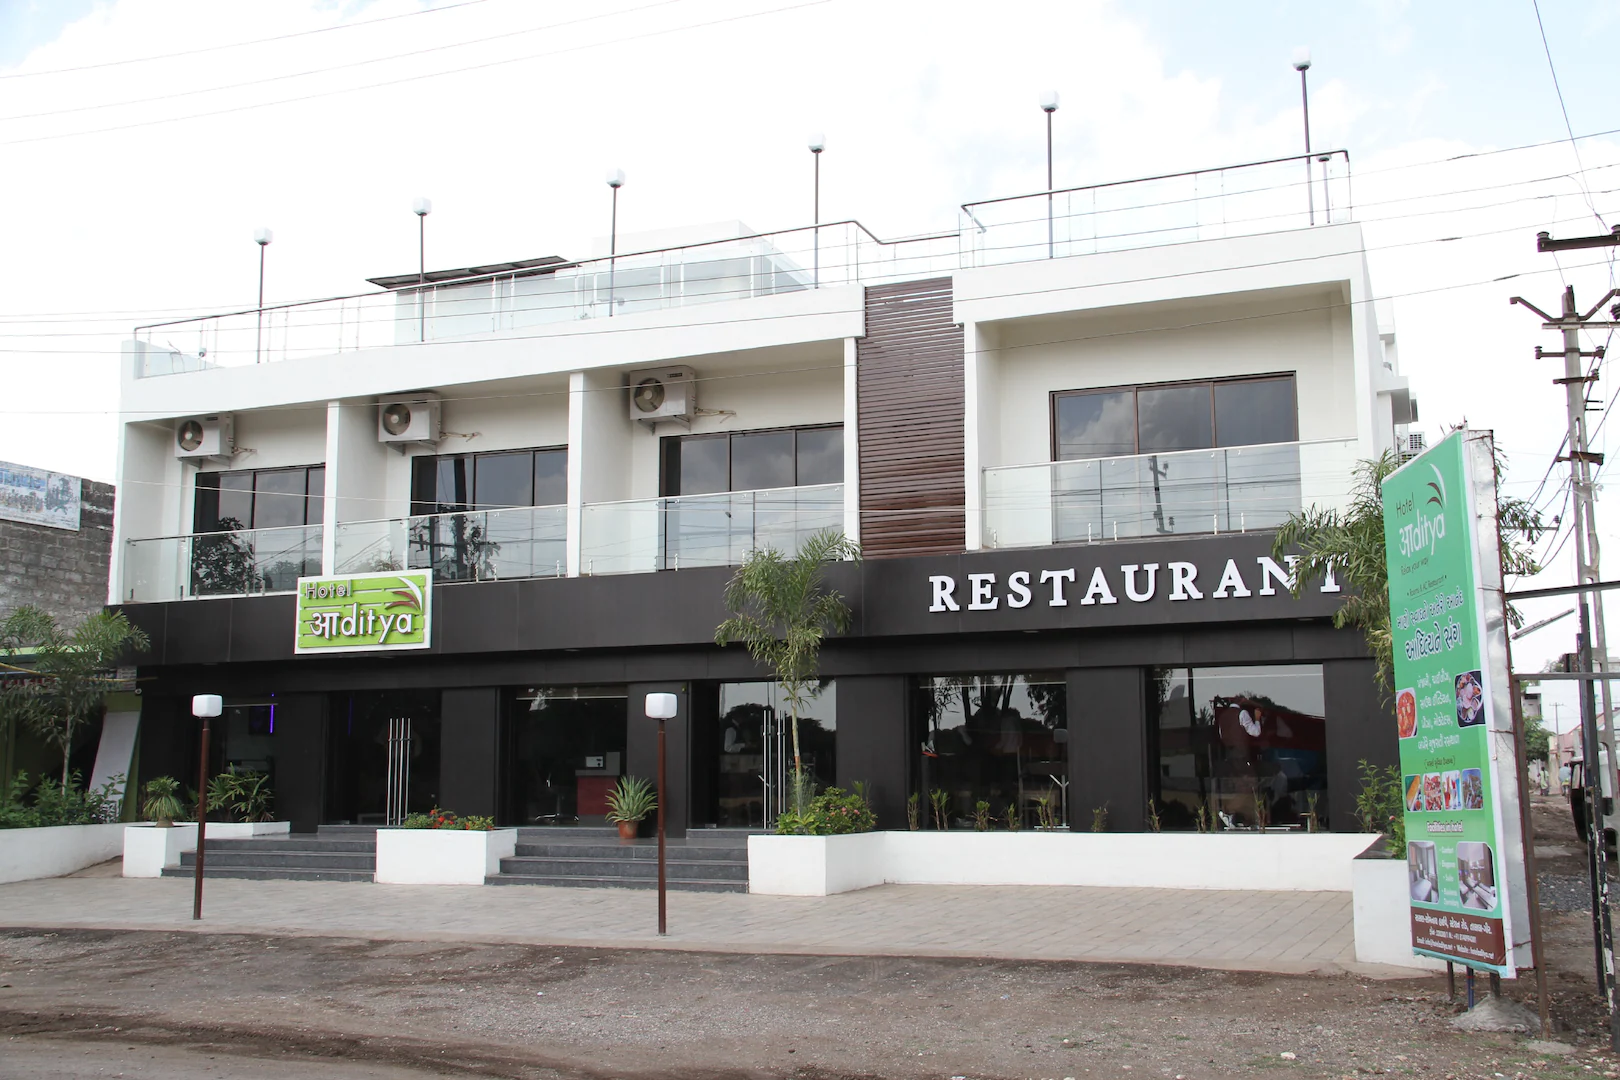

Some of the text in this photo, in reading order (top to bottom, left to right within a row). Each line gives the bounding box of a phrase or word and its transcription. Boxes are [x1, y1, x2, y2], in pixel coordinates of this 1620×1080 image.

[1396, 492, 1414, 518] Hotel
[306, 579, 352, 599] Hotel
[929, 553, 1349, 612] RESTAURANT
[1405, 615, 1462, 660] આદિત્યને સંગ
[1451, 820, 1464, 833] hotel
